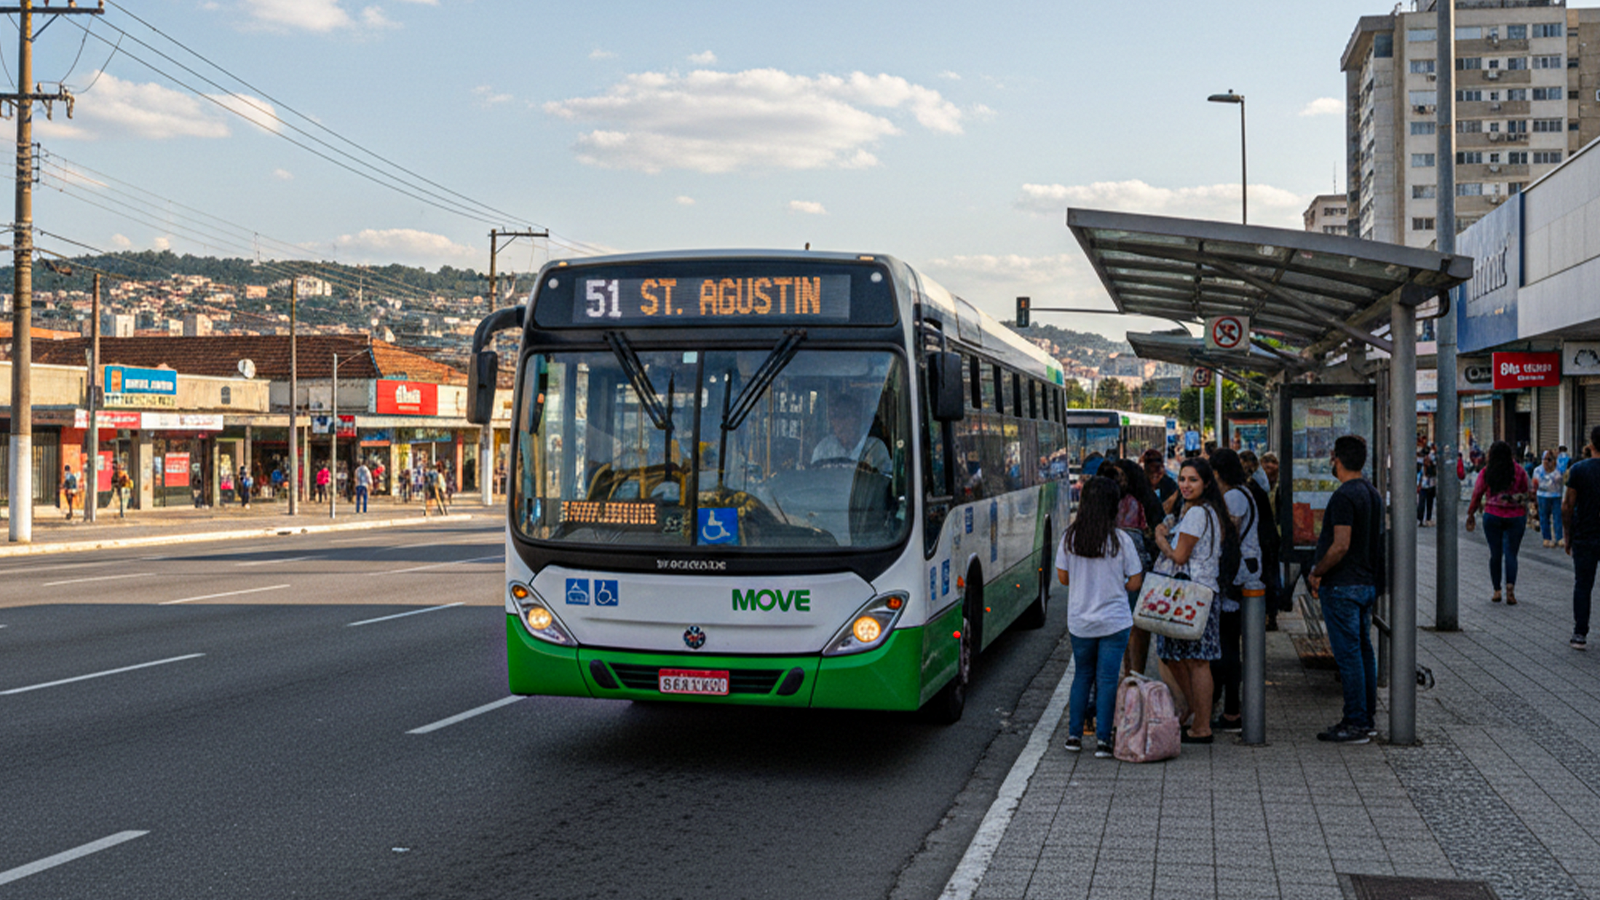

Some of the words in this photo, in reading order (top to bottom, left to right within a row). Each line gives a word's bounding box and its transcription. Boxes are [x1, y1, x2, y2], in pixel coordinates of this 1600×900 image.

[586, 279, 622, 317] 51
[640, 278, 683, 316] ST.
[700, 276, 821, 315] AGUSTIN
[732, 588, 811, 612] MOVE
